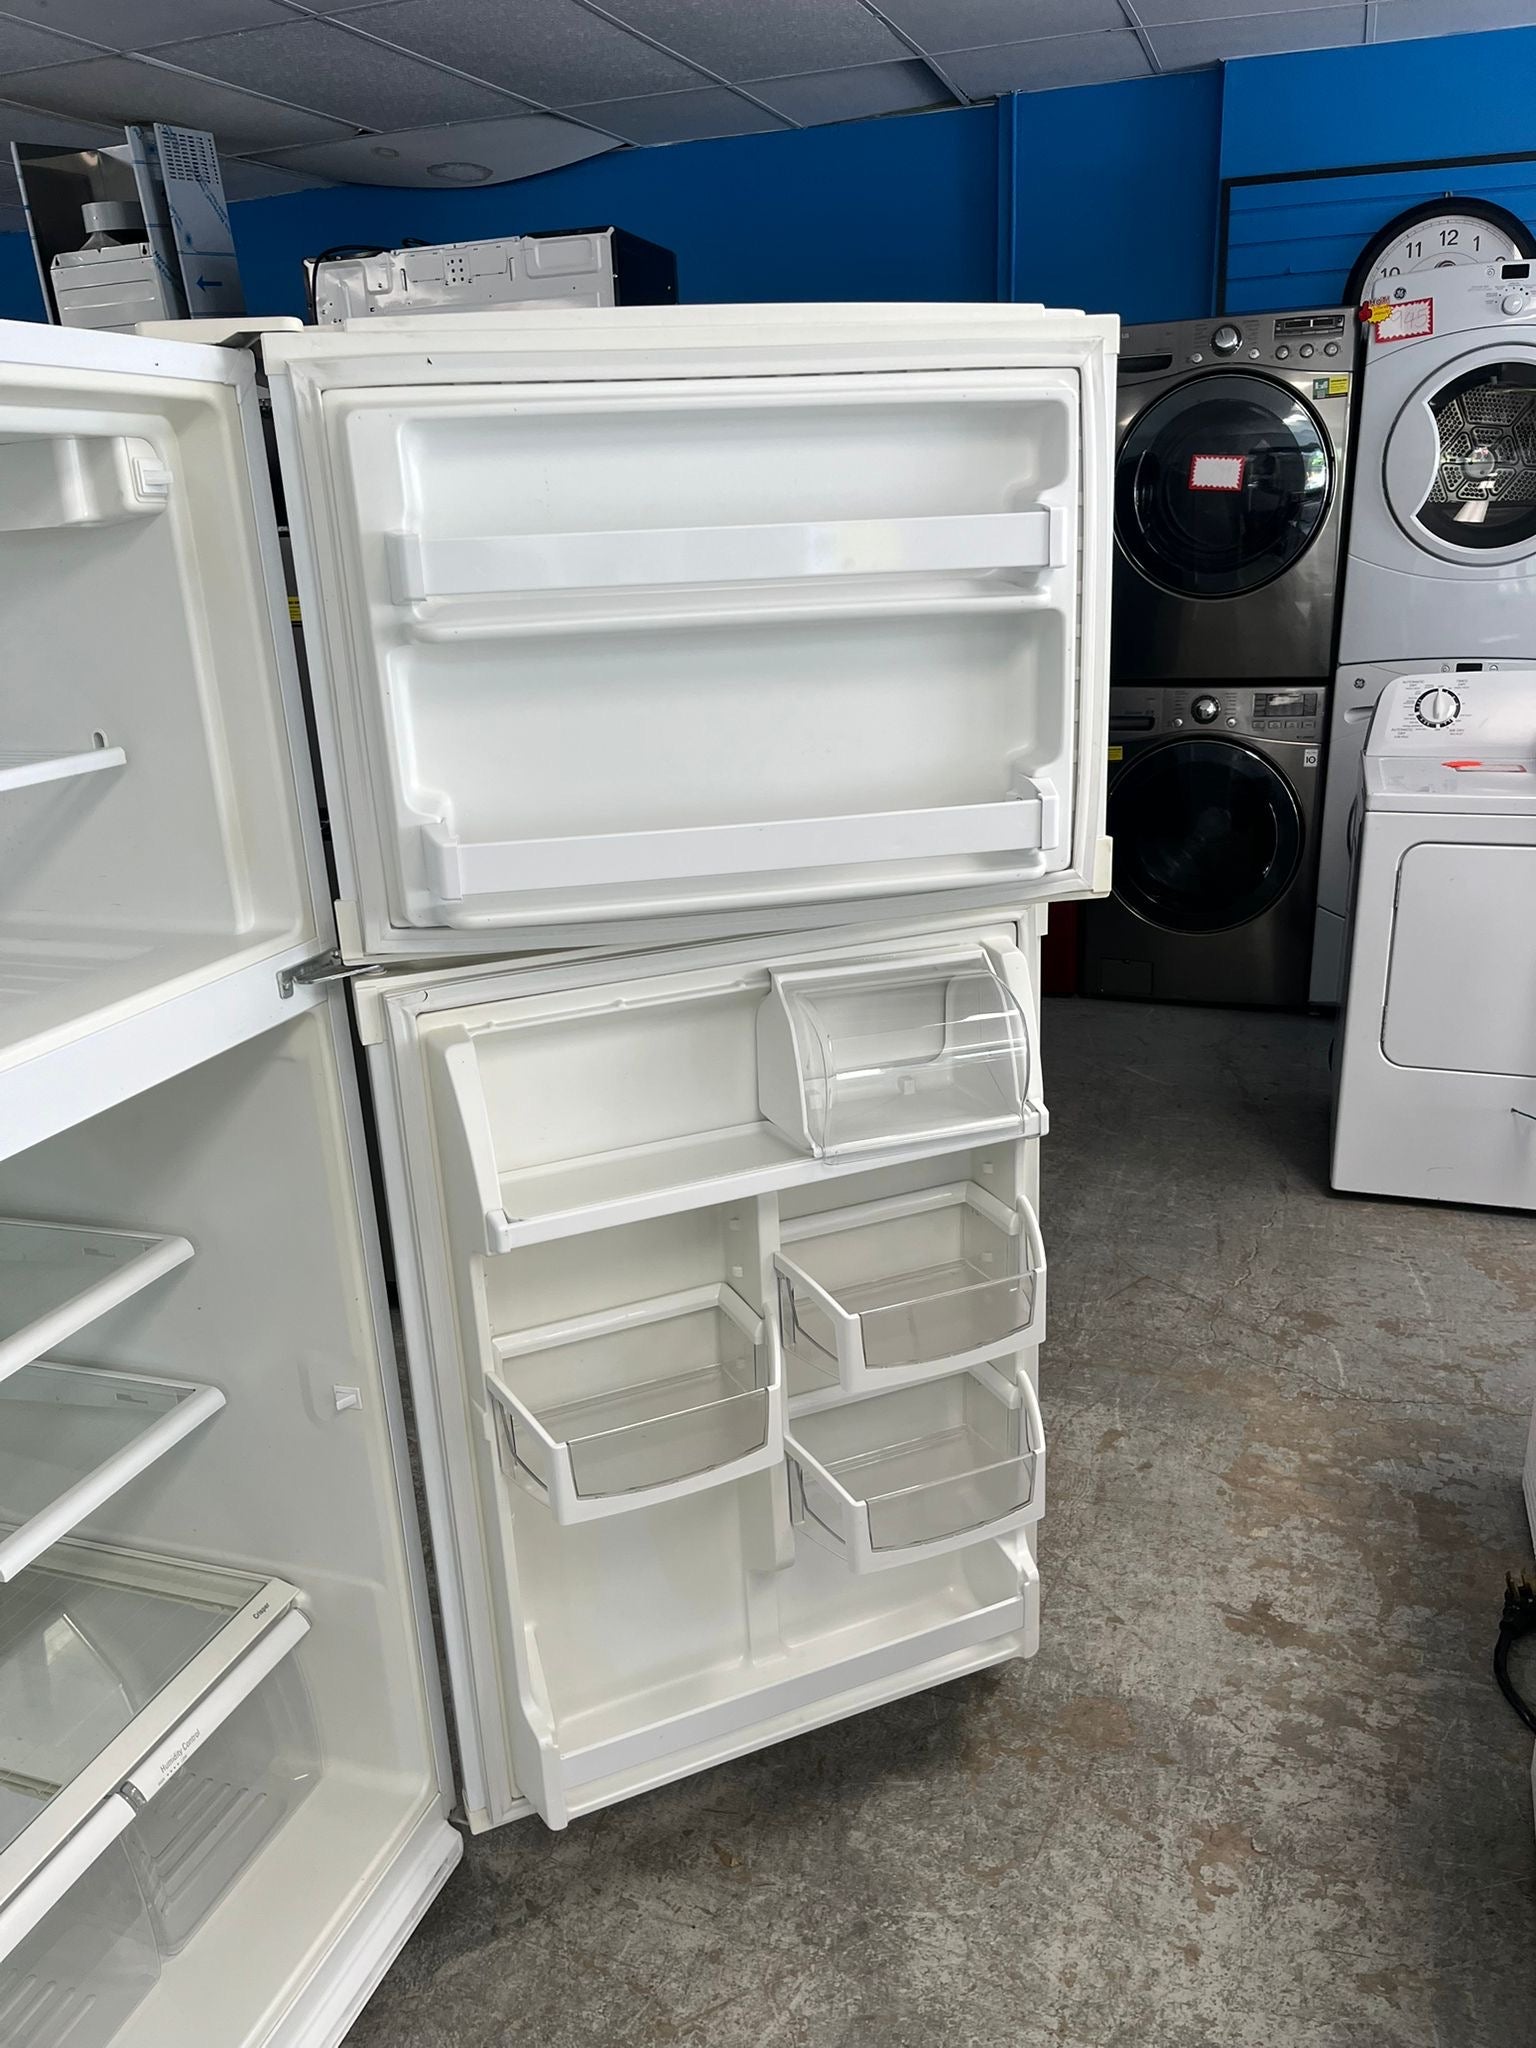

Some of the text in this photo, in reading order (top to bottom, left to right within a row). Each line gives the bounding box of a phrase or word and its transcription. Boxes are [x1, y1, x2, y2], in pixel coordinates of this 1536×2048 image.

[1440, 229, 1459, 246] 12
[1473, 235, 1480, 251] 1
[1405, 241, 1422, 258] 11
[252, 1602, 270, 1620] Crisper
[160, 1728, 200, 1773] Humidity Control
